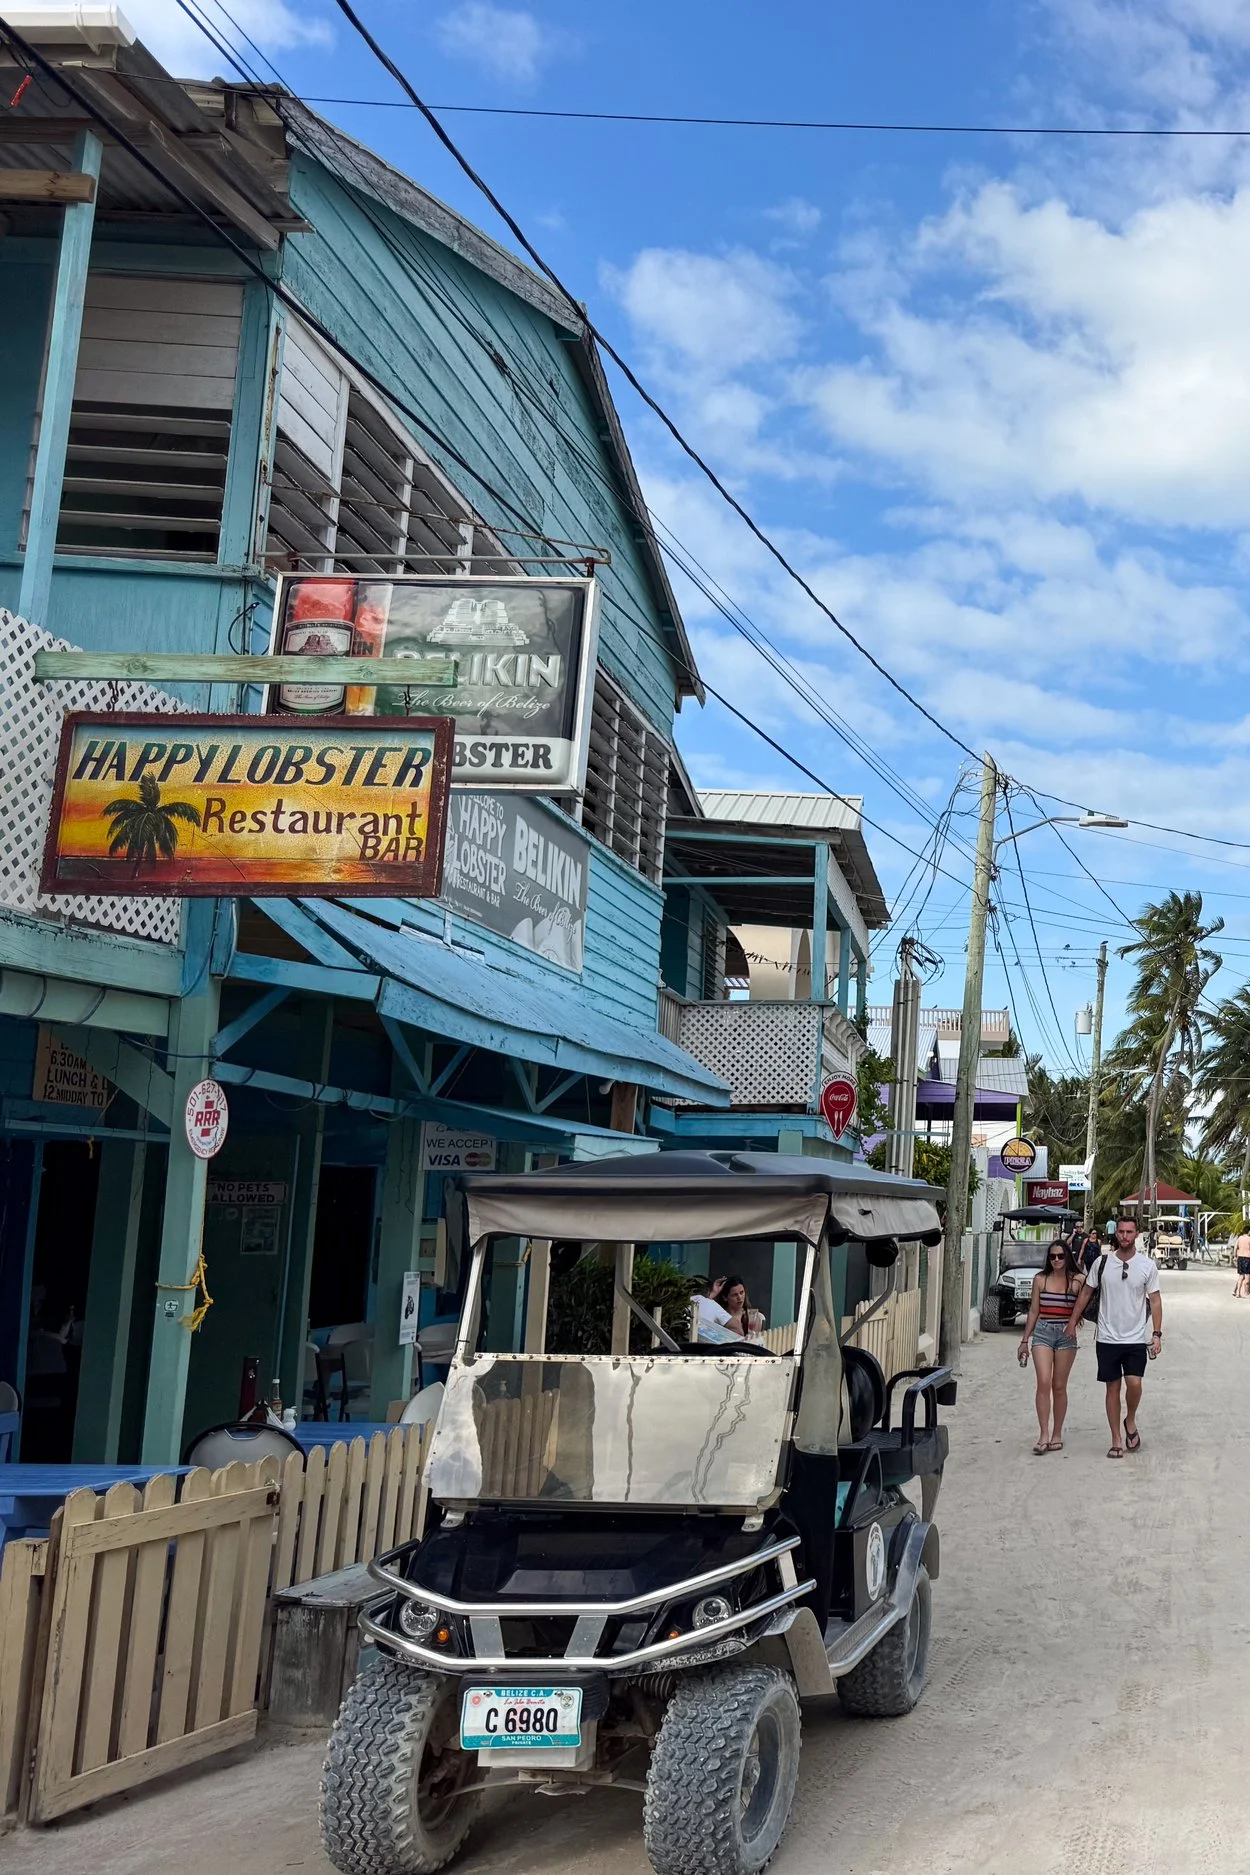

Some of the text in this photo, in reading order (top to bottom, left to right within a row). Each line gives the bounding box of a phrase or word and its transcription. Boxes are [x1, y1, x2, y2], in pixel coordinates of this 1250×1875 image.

[393, 650, 562, 688] IKIN
[392, 690, 551, 719] The Beer of Belize
[72, 740, 432, 788] HAPPY LOBSTER
[453, 742, 552, 769] BSTER
[202, 797, 423, 837] Restaurant
[496, 802, 504, 820] TO
[458, 795, 507, 857] HAPPY
[359, 834, 423, 861] BAR
[452, 833, 507, 896] LOBSTER
[513, 814, 582, 910] BELIKIN
[513, 880, 530, 906] The
[529, 893, 548, 917] Beer
[47, 1067, 87, 1088] LUNCH
[824, 1075, 856, 1086] ENJOY MORE
[195, 1110, 221, 1128] RRR
[426, 1139, 445, 1149] WE
[428, 1154, 460, 1167] VISA
[211, 1194, 276, 1203] ALLOWED
[217, 1183, 270, 1192] NO PETS
[501, 1689, 547, 1697] BELIZE C.A.
[485, 1707, 559, 1734] C 6980
